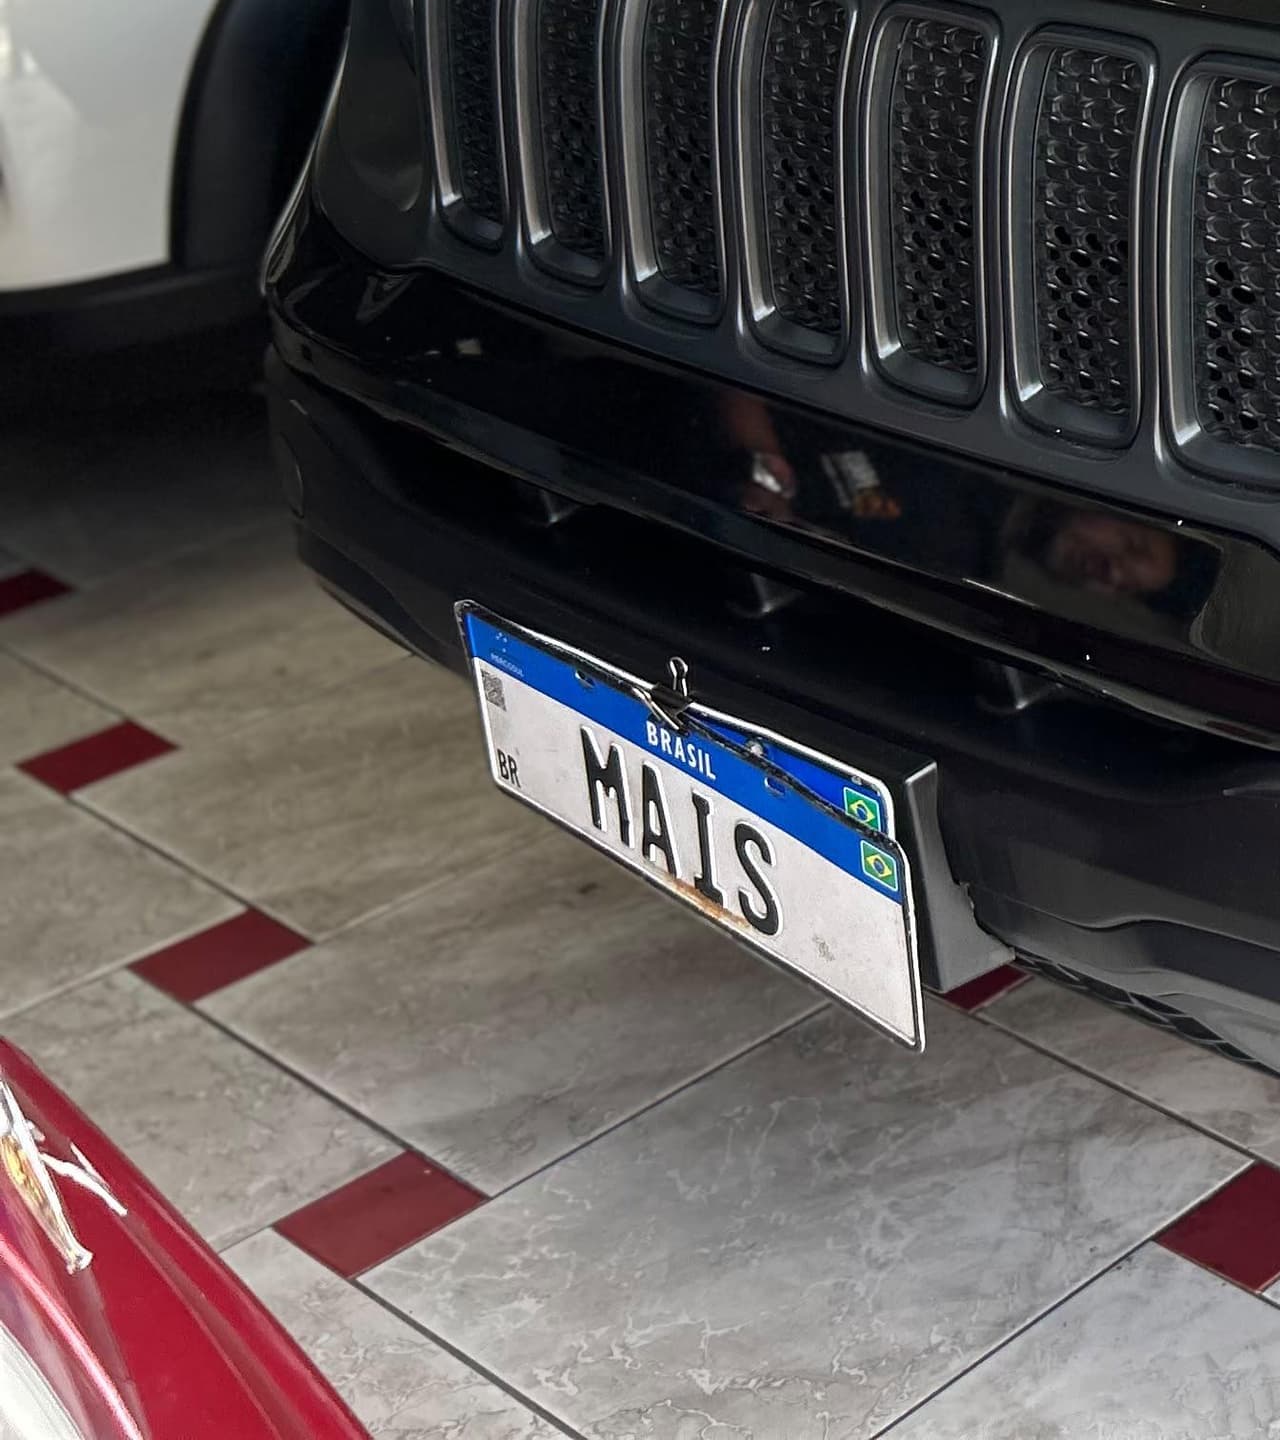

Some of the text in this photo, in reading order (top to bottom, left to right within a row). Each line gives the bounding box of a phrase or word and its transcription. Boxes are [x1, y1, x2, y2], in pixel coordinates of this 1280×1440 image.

[497, 748, 521, 788] BR
[646, 720, 717, 781] BRASIL
[580, 725, 783, 937] MAIS
